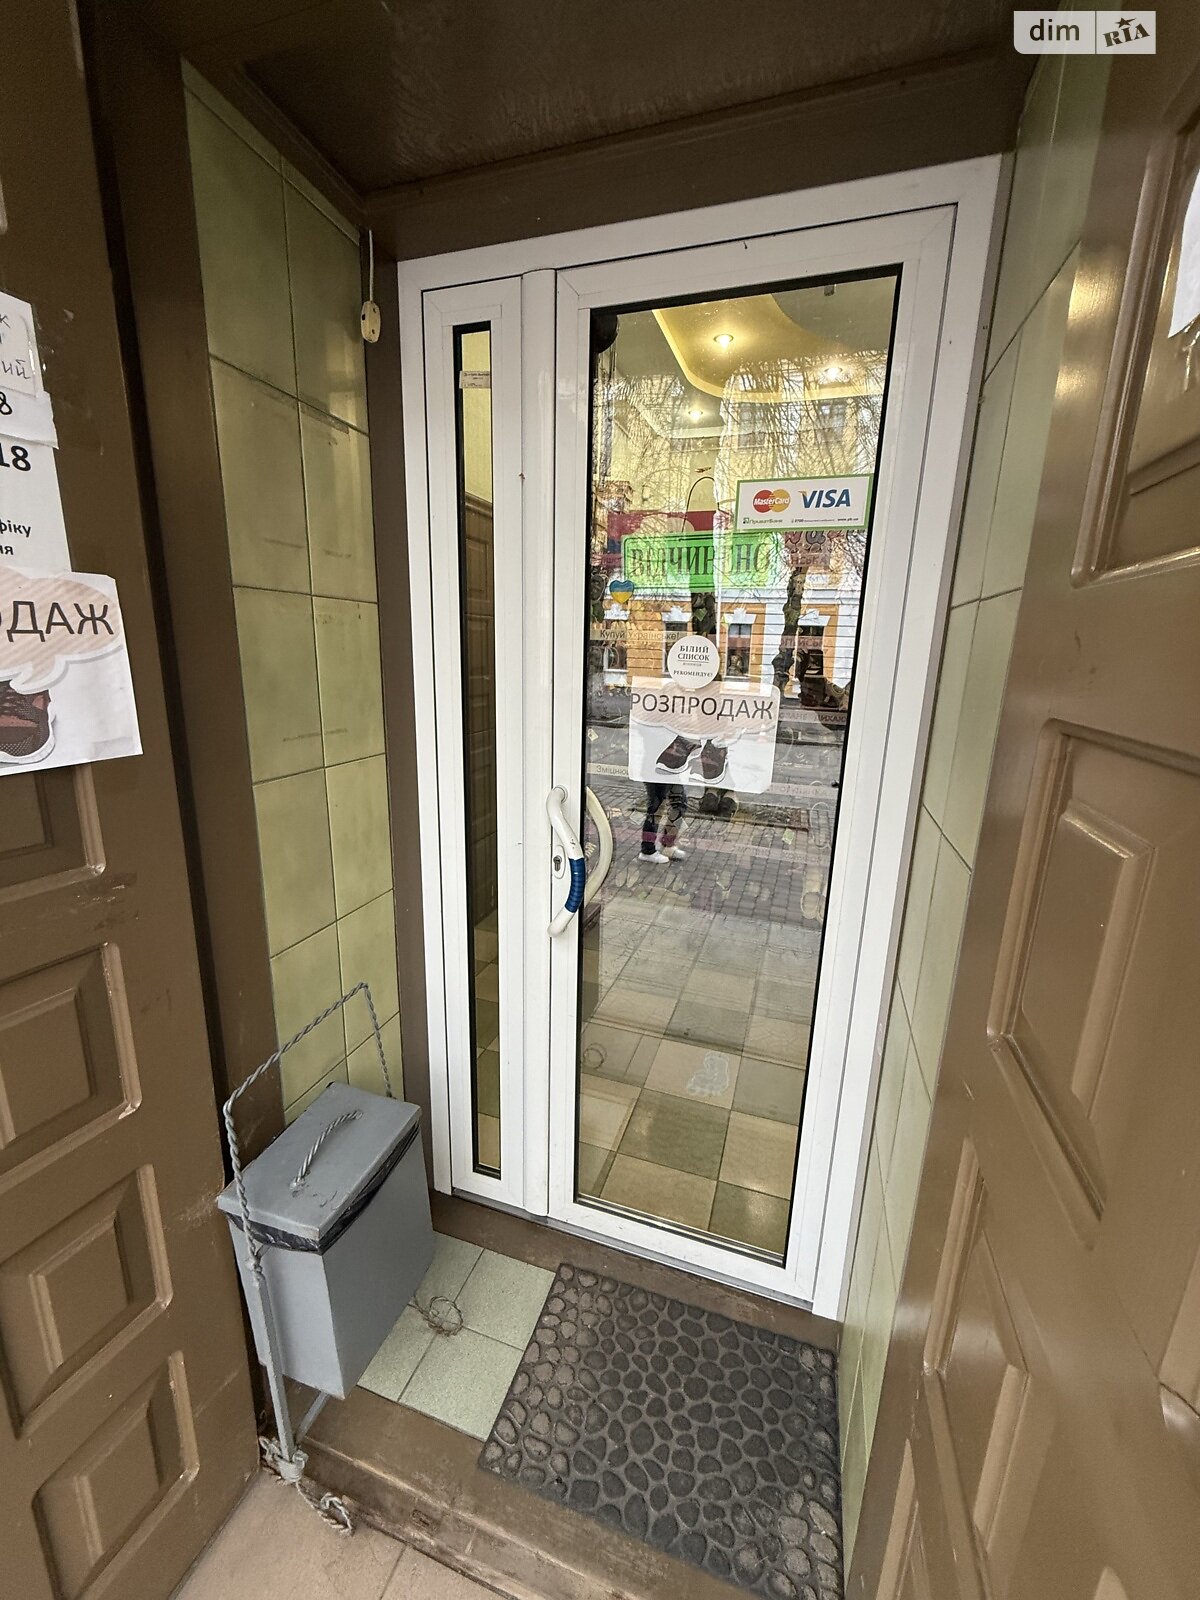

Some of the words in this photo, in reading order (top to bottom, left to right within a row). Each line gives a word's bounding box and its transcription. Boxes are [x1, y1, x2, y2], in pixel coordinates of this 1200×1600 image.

[753, 497, 790, 506] MasterCard
[799, 488, 851, 509] VISA
[0, 600, 115, 642] ДАЖ
[600, 629, 625, 641] Купуй
[677, 653, 710, 661] СПИСОК
[679, 645, 709, 654] БІЛИЙ
[630, 692, 773, 722] РОЗПРОДАЖ
